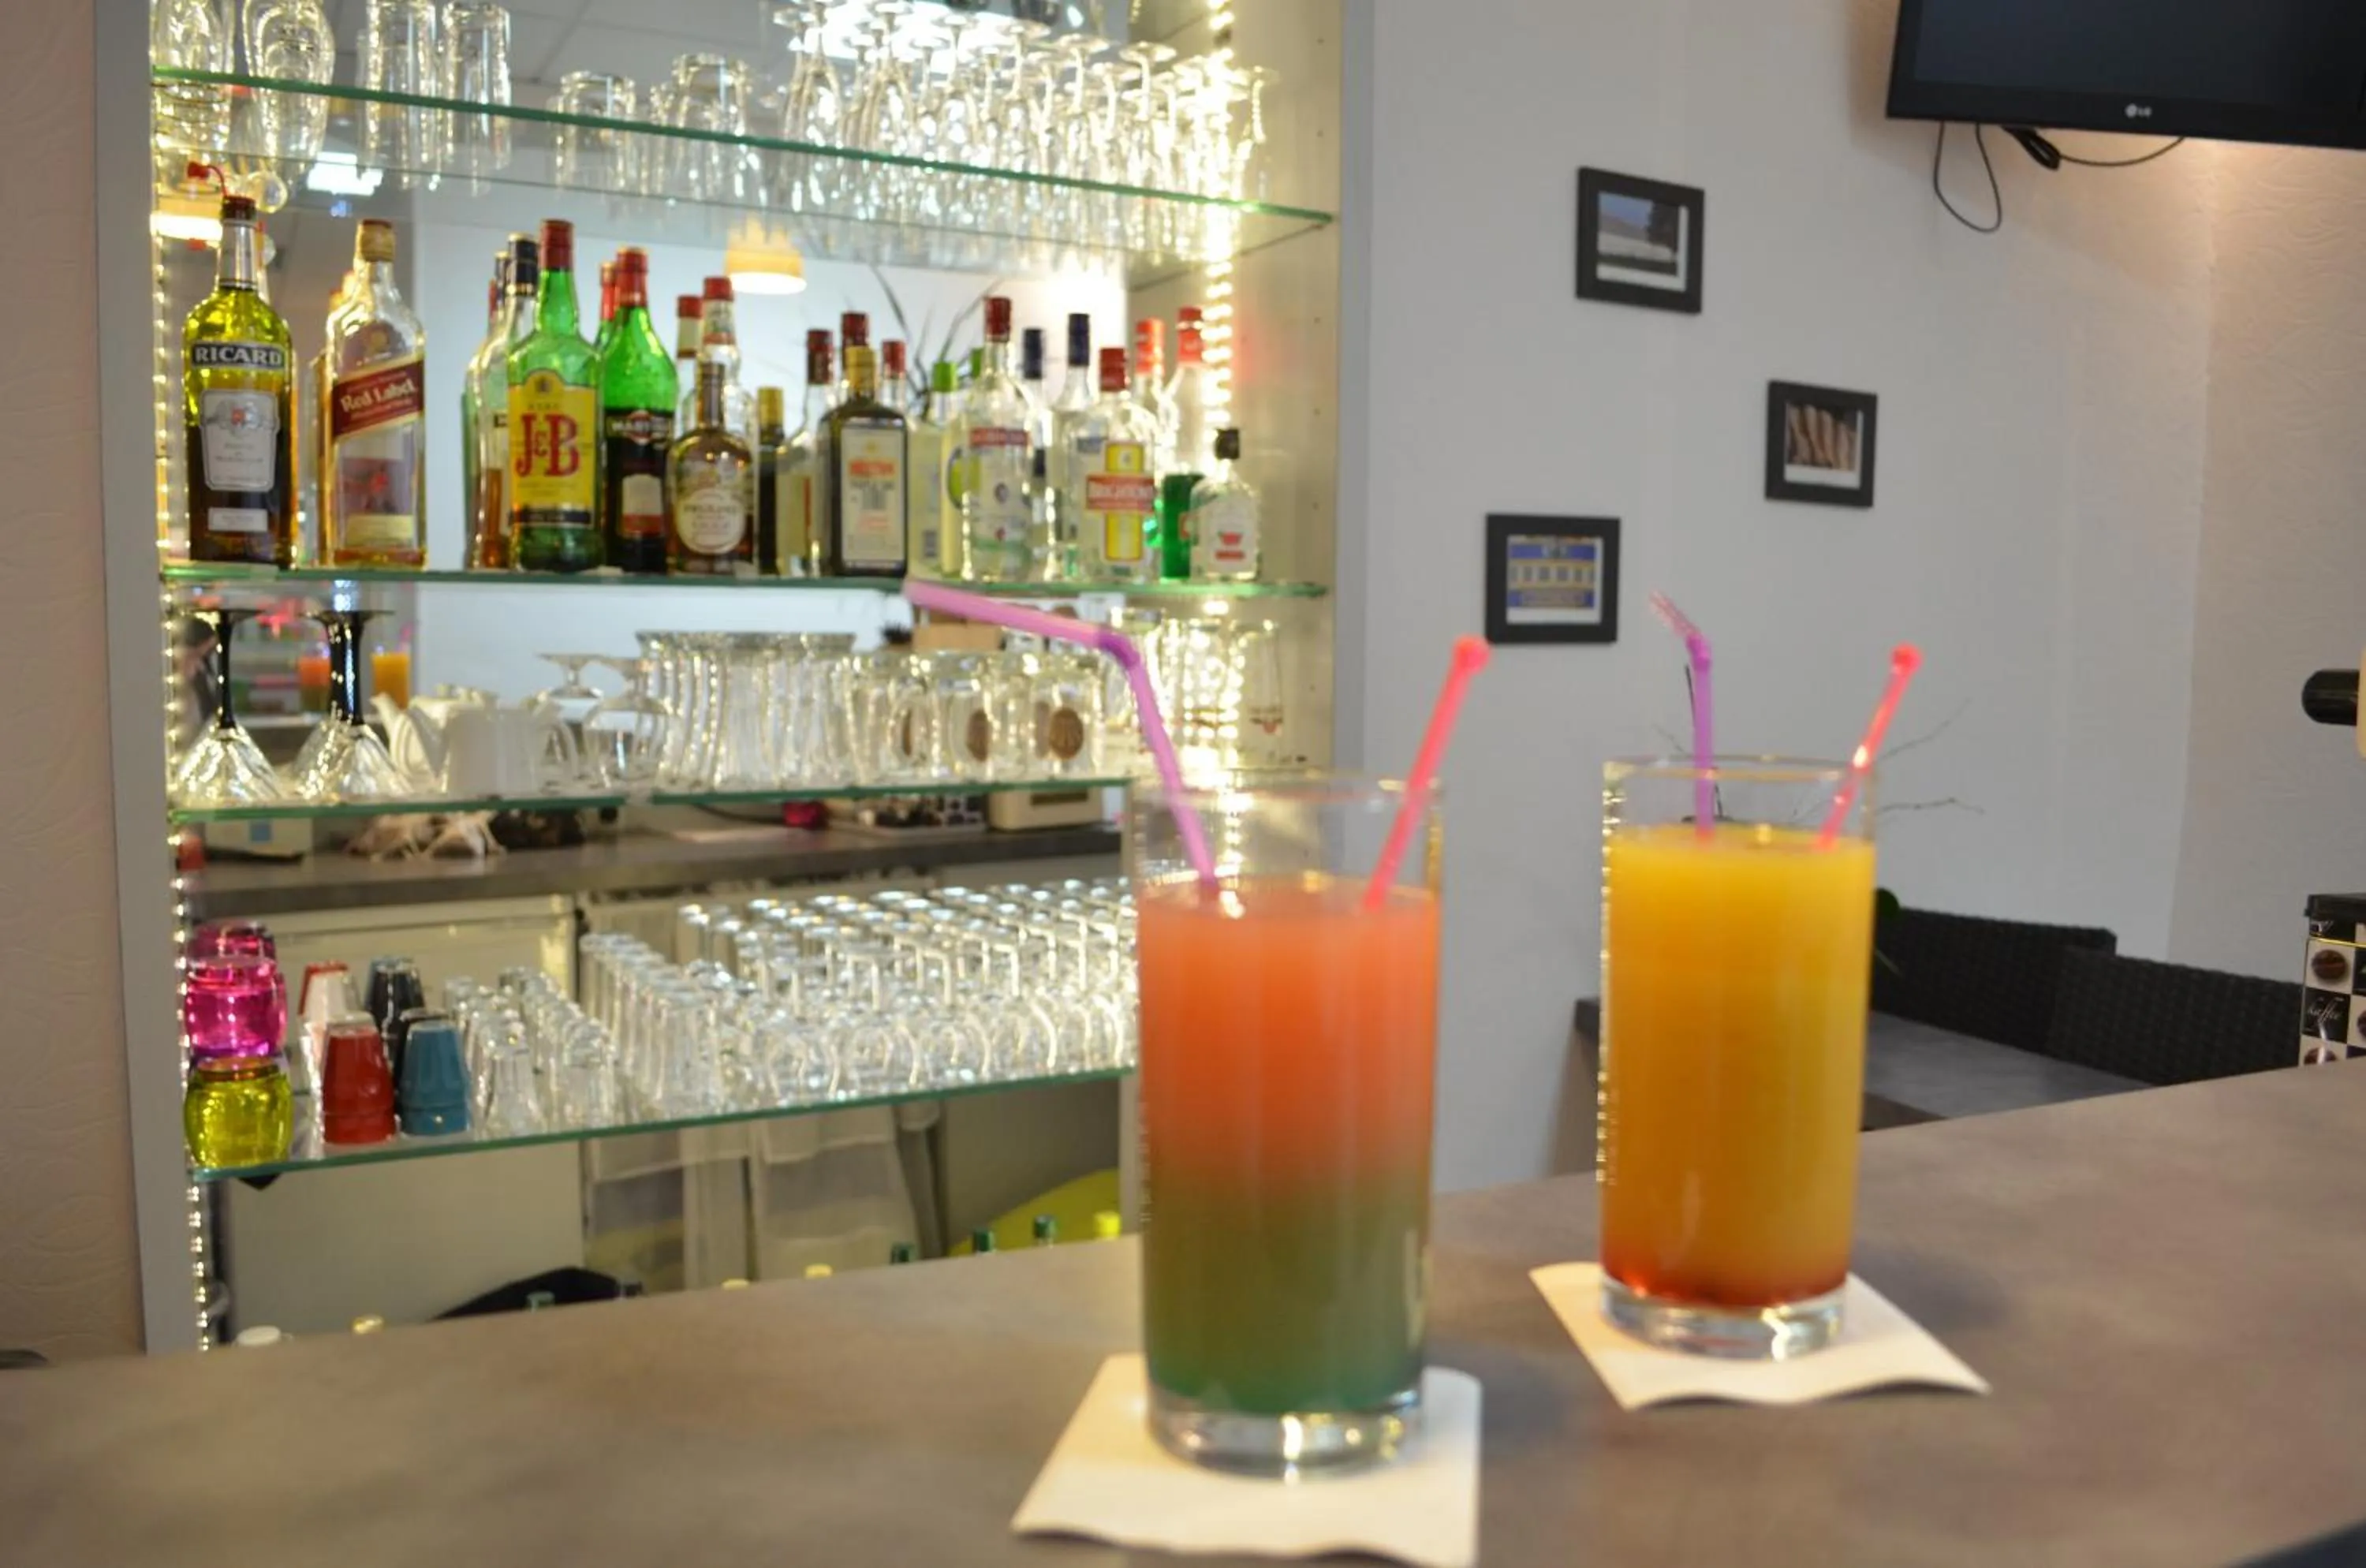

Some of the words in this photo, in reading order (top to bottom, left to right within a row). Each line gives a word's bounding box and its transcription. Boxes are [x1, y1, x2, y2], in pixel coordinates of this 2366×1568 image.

[194, 345, 282, 366] RICARD
[340, 389, 373, 413] Red
[373, 378, 418, 402] Label
